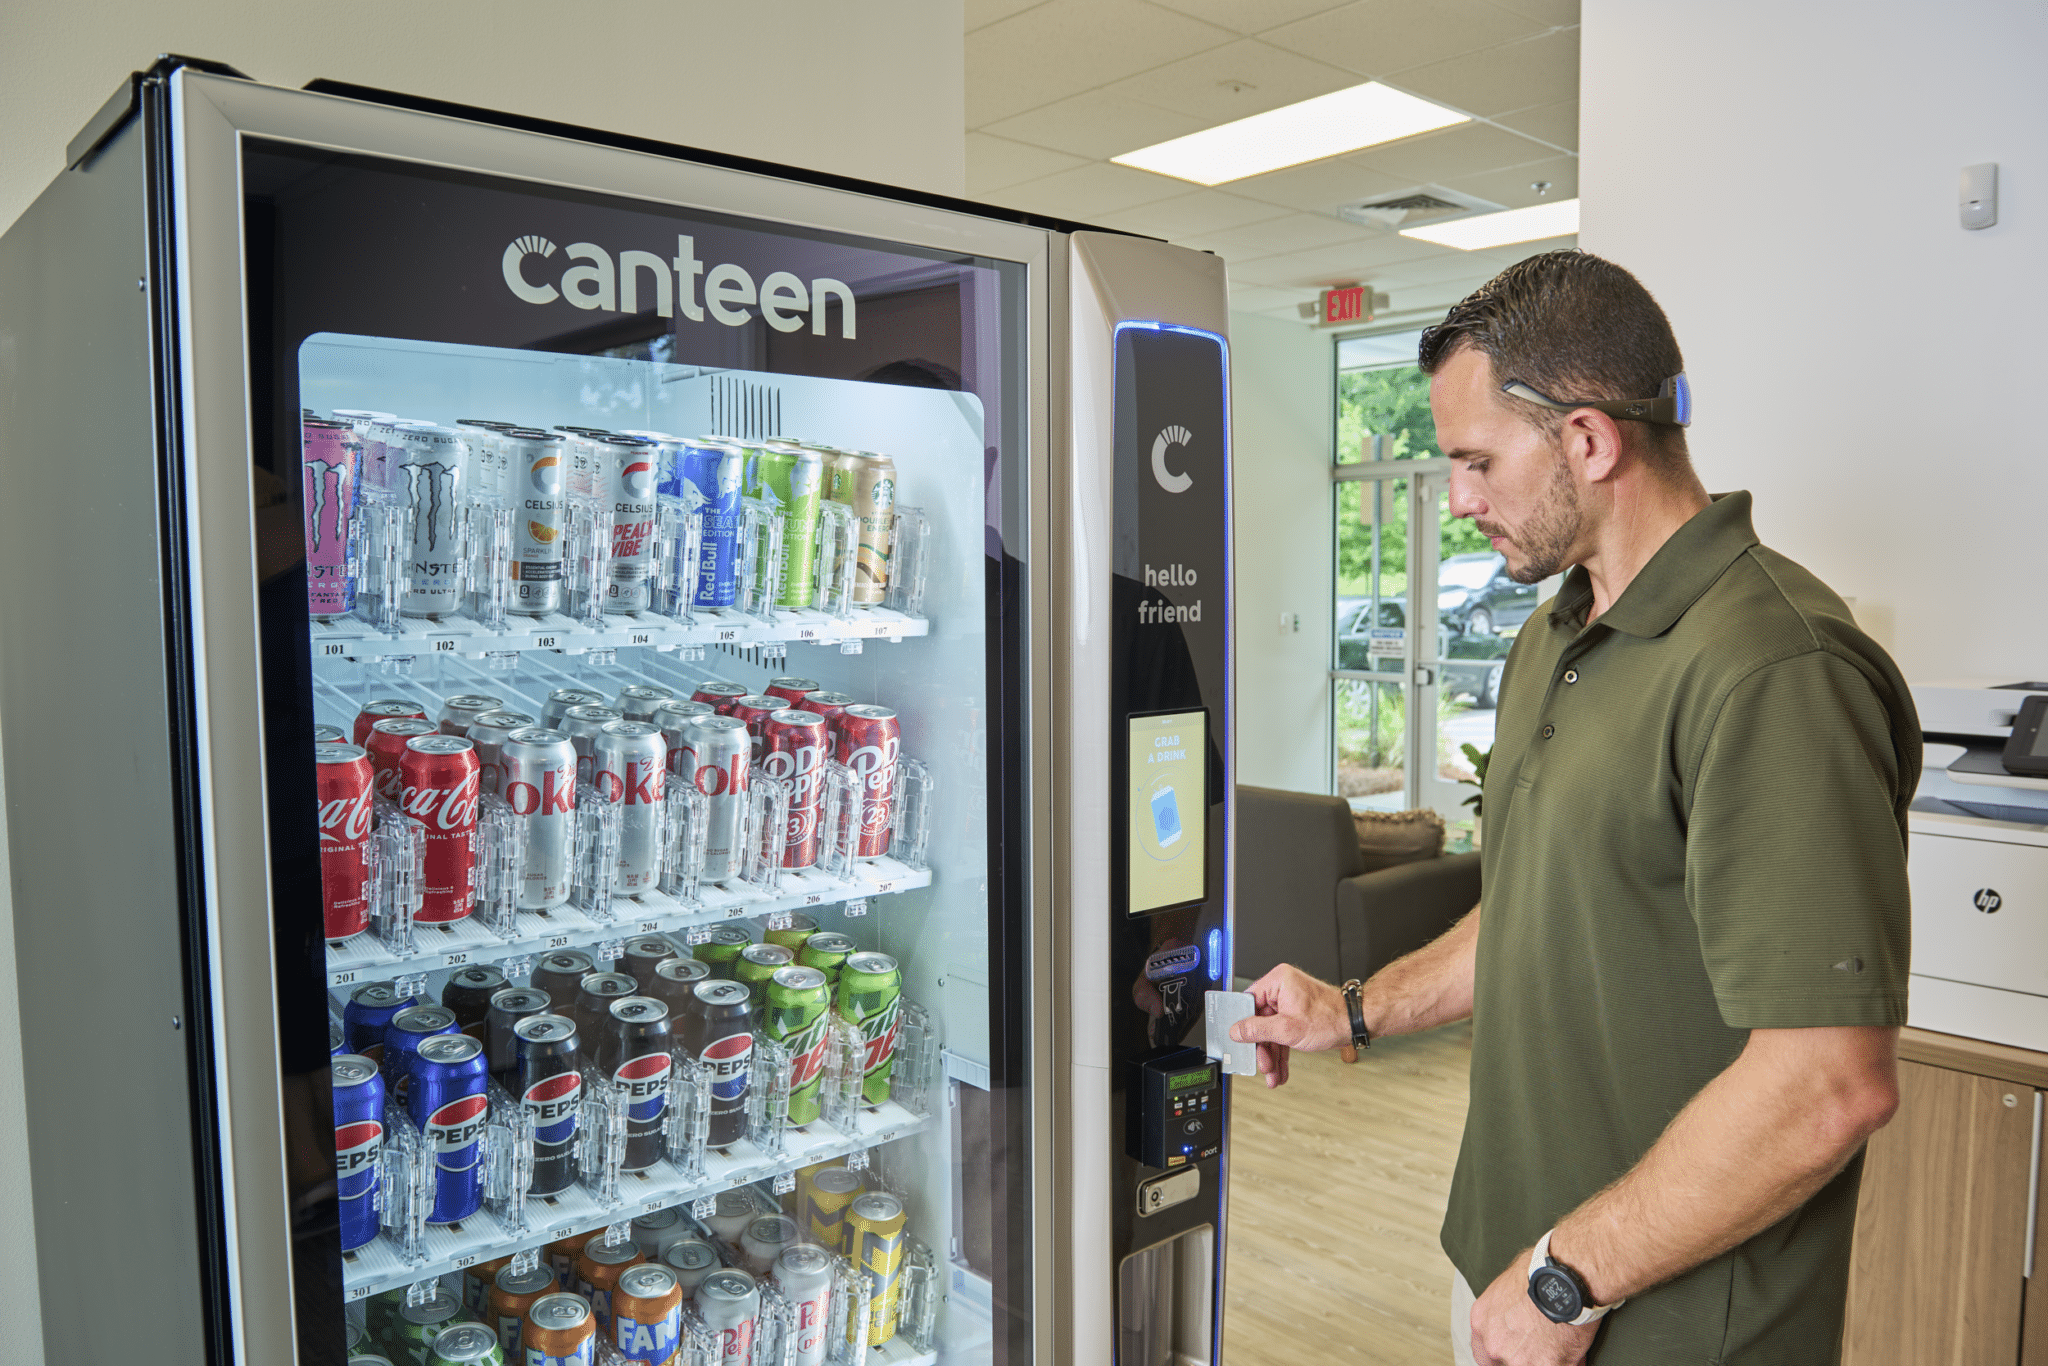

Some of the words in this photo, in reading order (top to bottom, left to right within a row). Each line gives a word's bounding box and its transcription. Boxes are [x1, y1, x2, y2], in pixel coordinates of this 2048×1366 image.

[502, 234, 856, 339] canteen
[1327, 287, 1364, 322] EXIT
[402, 434, 428, 443] ZERO
[525, 499, 563, 510] CELSIUS
[615, 502, 653, 513] CELSIUS
[703, 529, 735, 538] EDITION
[612, 539, 643, 557] VIBE
[1144, 564, 1197, 587] hello
[1137, 600, 1201, 624] friend
[720, 631, 735, 640] 105
[800, 630, 814, 638] 106
[874, 627, 888, 635] 107
[538, 637, 555, 647] 103
[632, 635, 648, 643] 104
[325, 644, 344, 655] 101
[436, 641, 455, 651] 102
[1154, 735, 1180, 748] GRAB
[1147, 753, 1155, 764] A
[1157, 749, 1187, 763] DRINK
[866, 806, 886, 825] 23
[879, 883, 892, 892] 207
[806, 895, 820, 904] 206
[1974, 888, 2001, 914] hp
[728, 907, 743, 917] 205
[641, 922, 658, 932] 204
[550, 937, 568, 947] 203
[448, 954, 466, 965] 202
[335, 972, 355, 984] 201
[702, 1057, 751, 1076] PEPS
[616, 1075, 668, 1096] PEPS
[525, 1094, 579, 1119] PEPS
[429, 1117, 485, 1144] PEPS
[881, 1132, 895, 1142] 307
[337, 1140, 382, 1170] EPS
[808, 1154, 823, 1164] 306
[732, 1176, 747, 1187] 305
[646, 1201, 662, 1213] 304
[555, 1227, 572, 1240] 303
[456, 1256, 475, 1268] 302
[352, 1287, 371, 1299] 301
